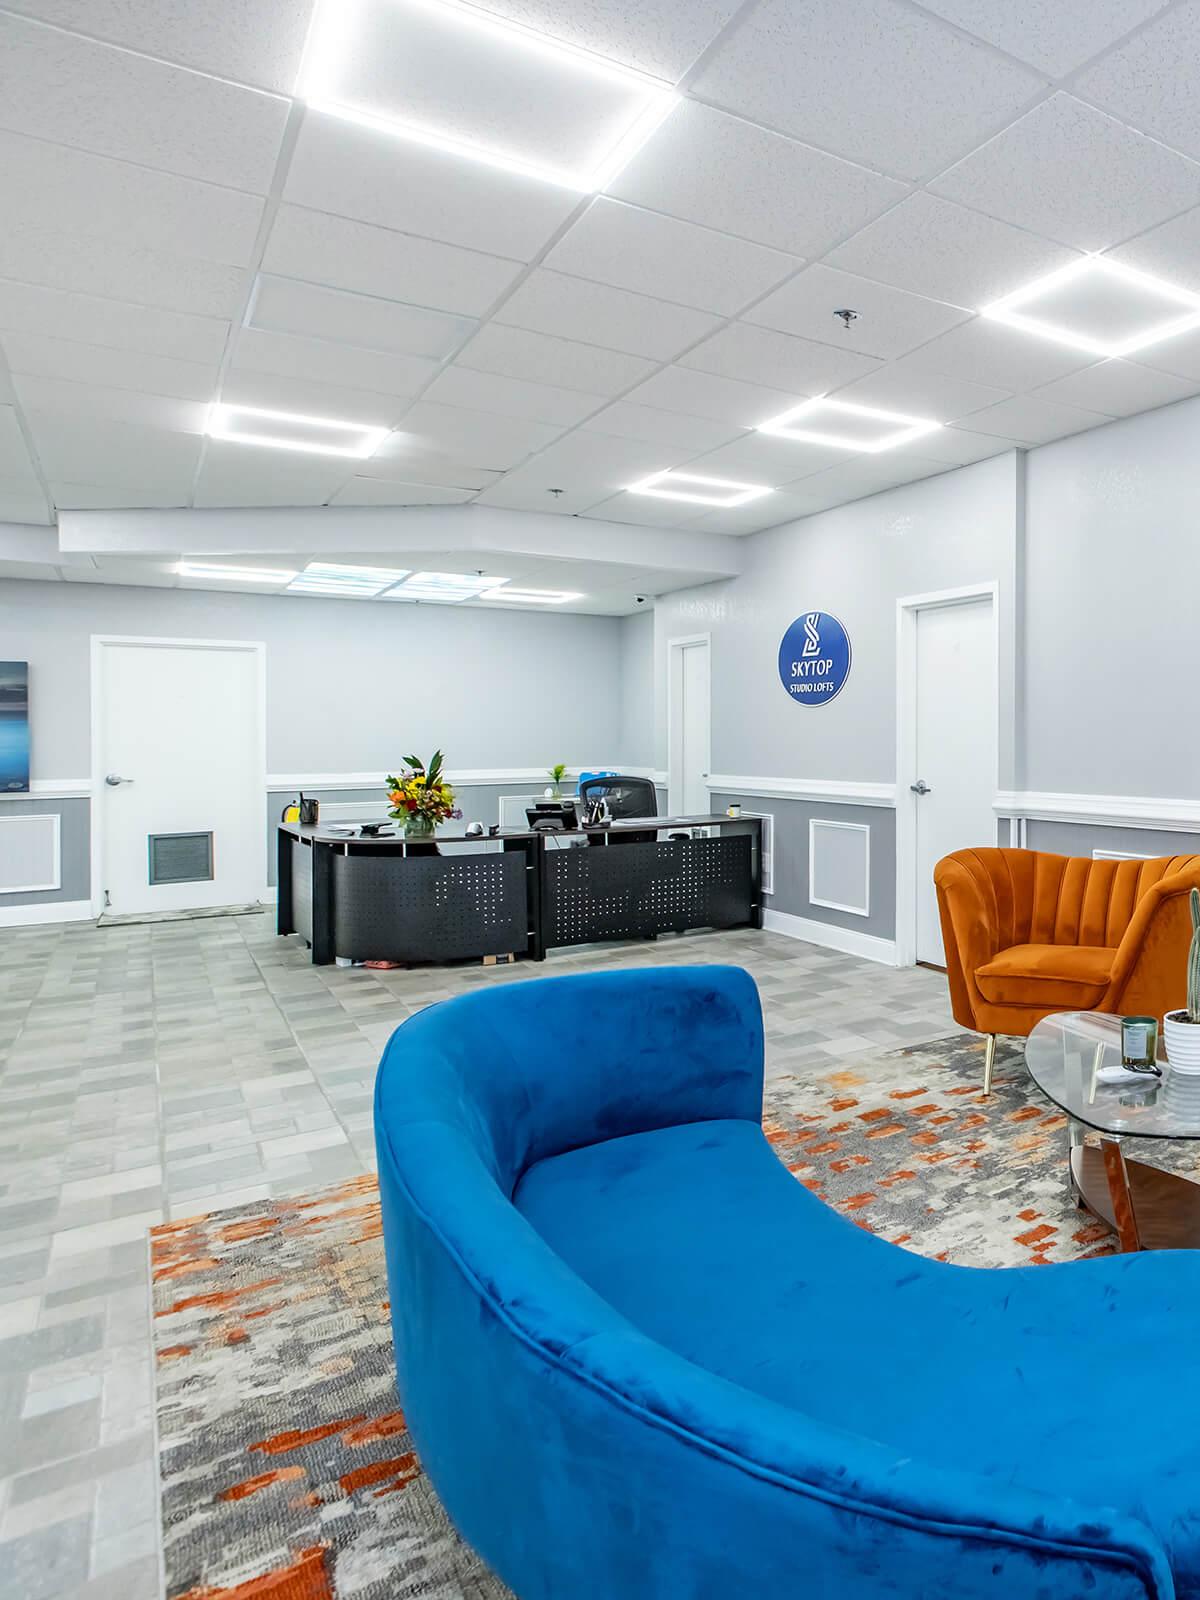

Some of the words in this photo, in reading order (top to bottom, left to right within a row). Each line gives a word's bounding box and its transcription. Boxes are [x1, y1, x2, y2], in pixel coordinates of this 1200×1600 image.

[791, 659, 833, 678] SKYTOP
[790, 683, 813, 694] STUDIO
[813, 681, 834, 692] LOFTS
